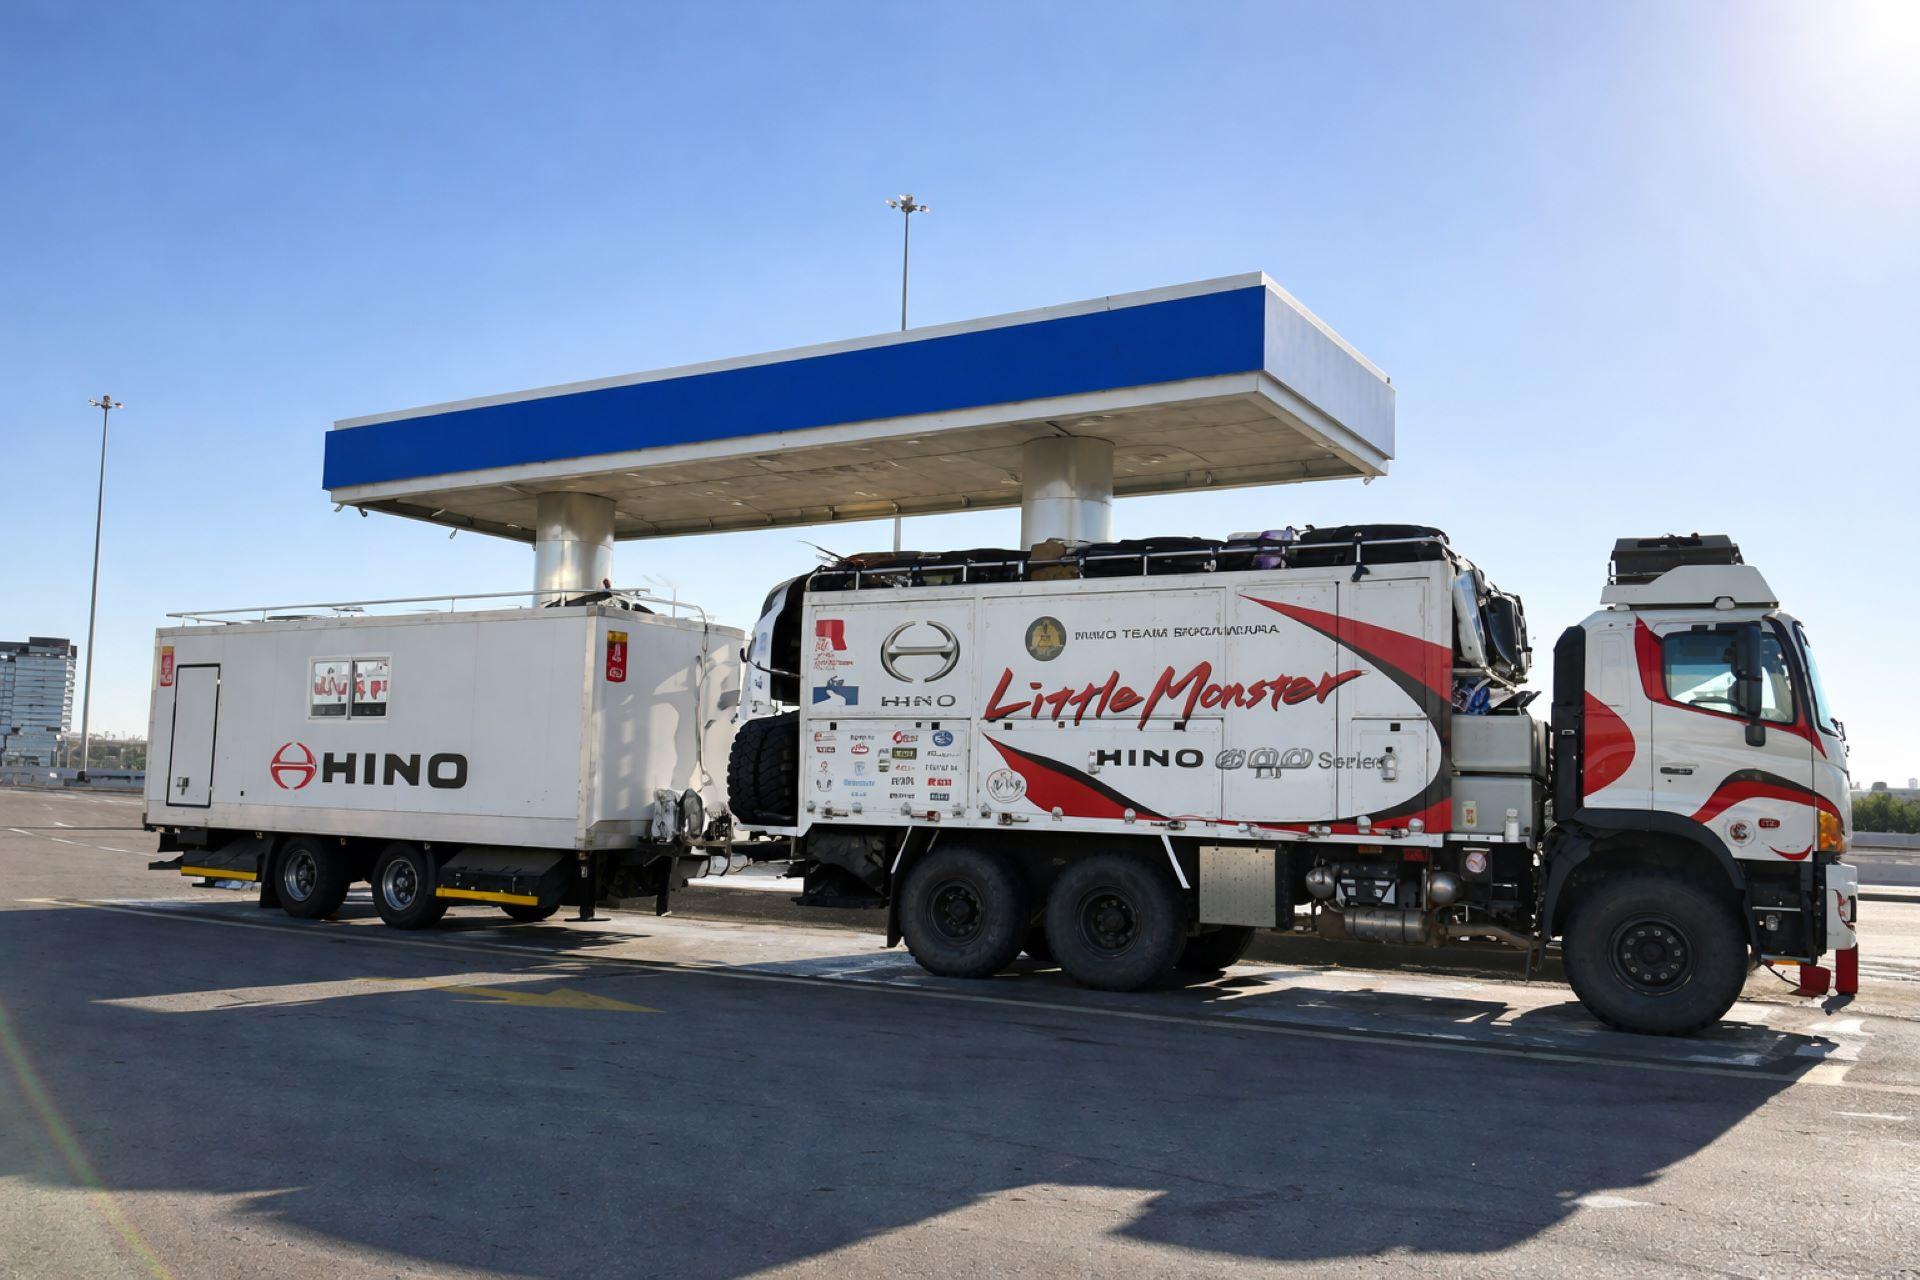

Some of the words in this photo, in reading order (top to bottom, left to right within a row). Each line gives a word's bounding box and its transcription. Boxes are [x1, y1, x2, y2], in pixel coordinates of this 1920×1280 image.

[984, 666, 1145, 725] Little
[1136, 660, 1370, 731] Monster
[322, 752, 468, 789] HINO
[1096, 749, 1204, 768] HINO
